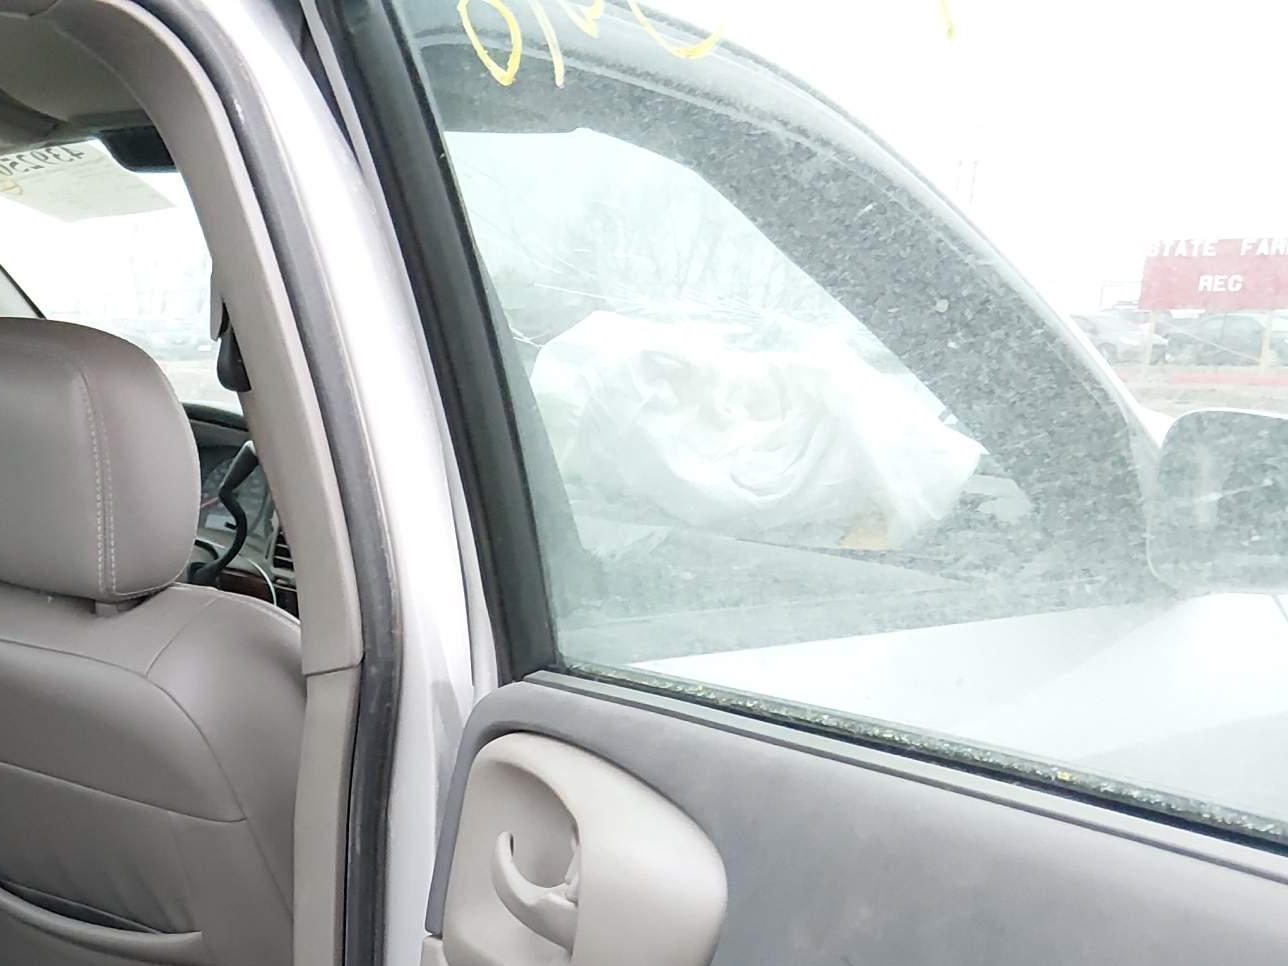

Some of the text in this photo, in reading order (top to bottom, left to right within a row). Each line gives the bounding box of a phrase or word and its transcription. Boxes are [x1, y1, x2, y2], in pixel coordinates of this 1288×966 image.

[1145, 238, 1288, 257] STATE FAR
[1198, 274, 1244, 292] REG
